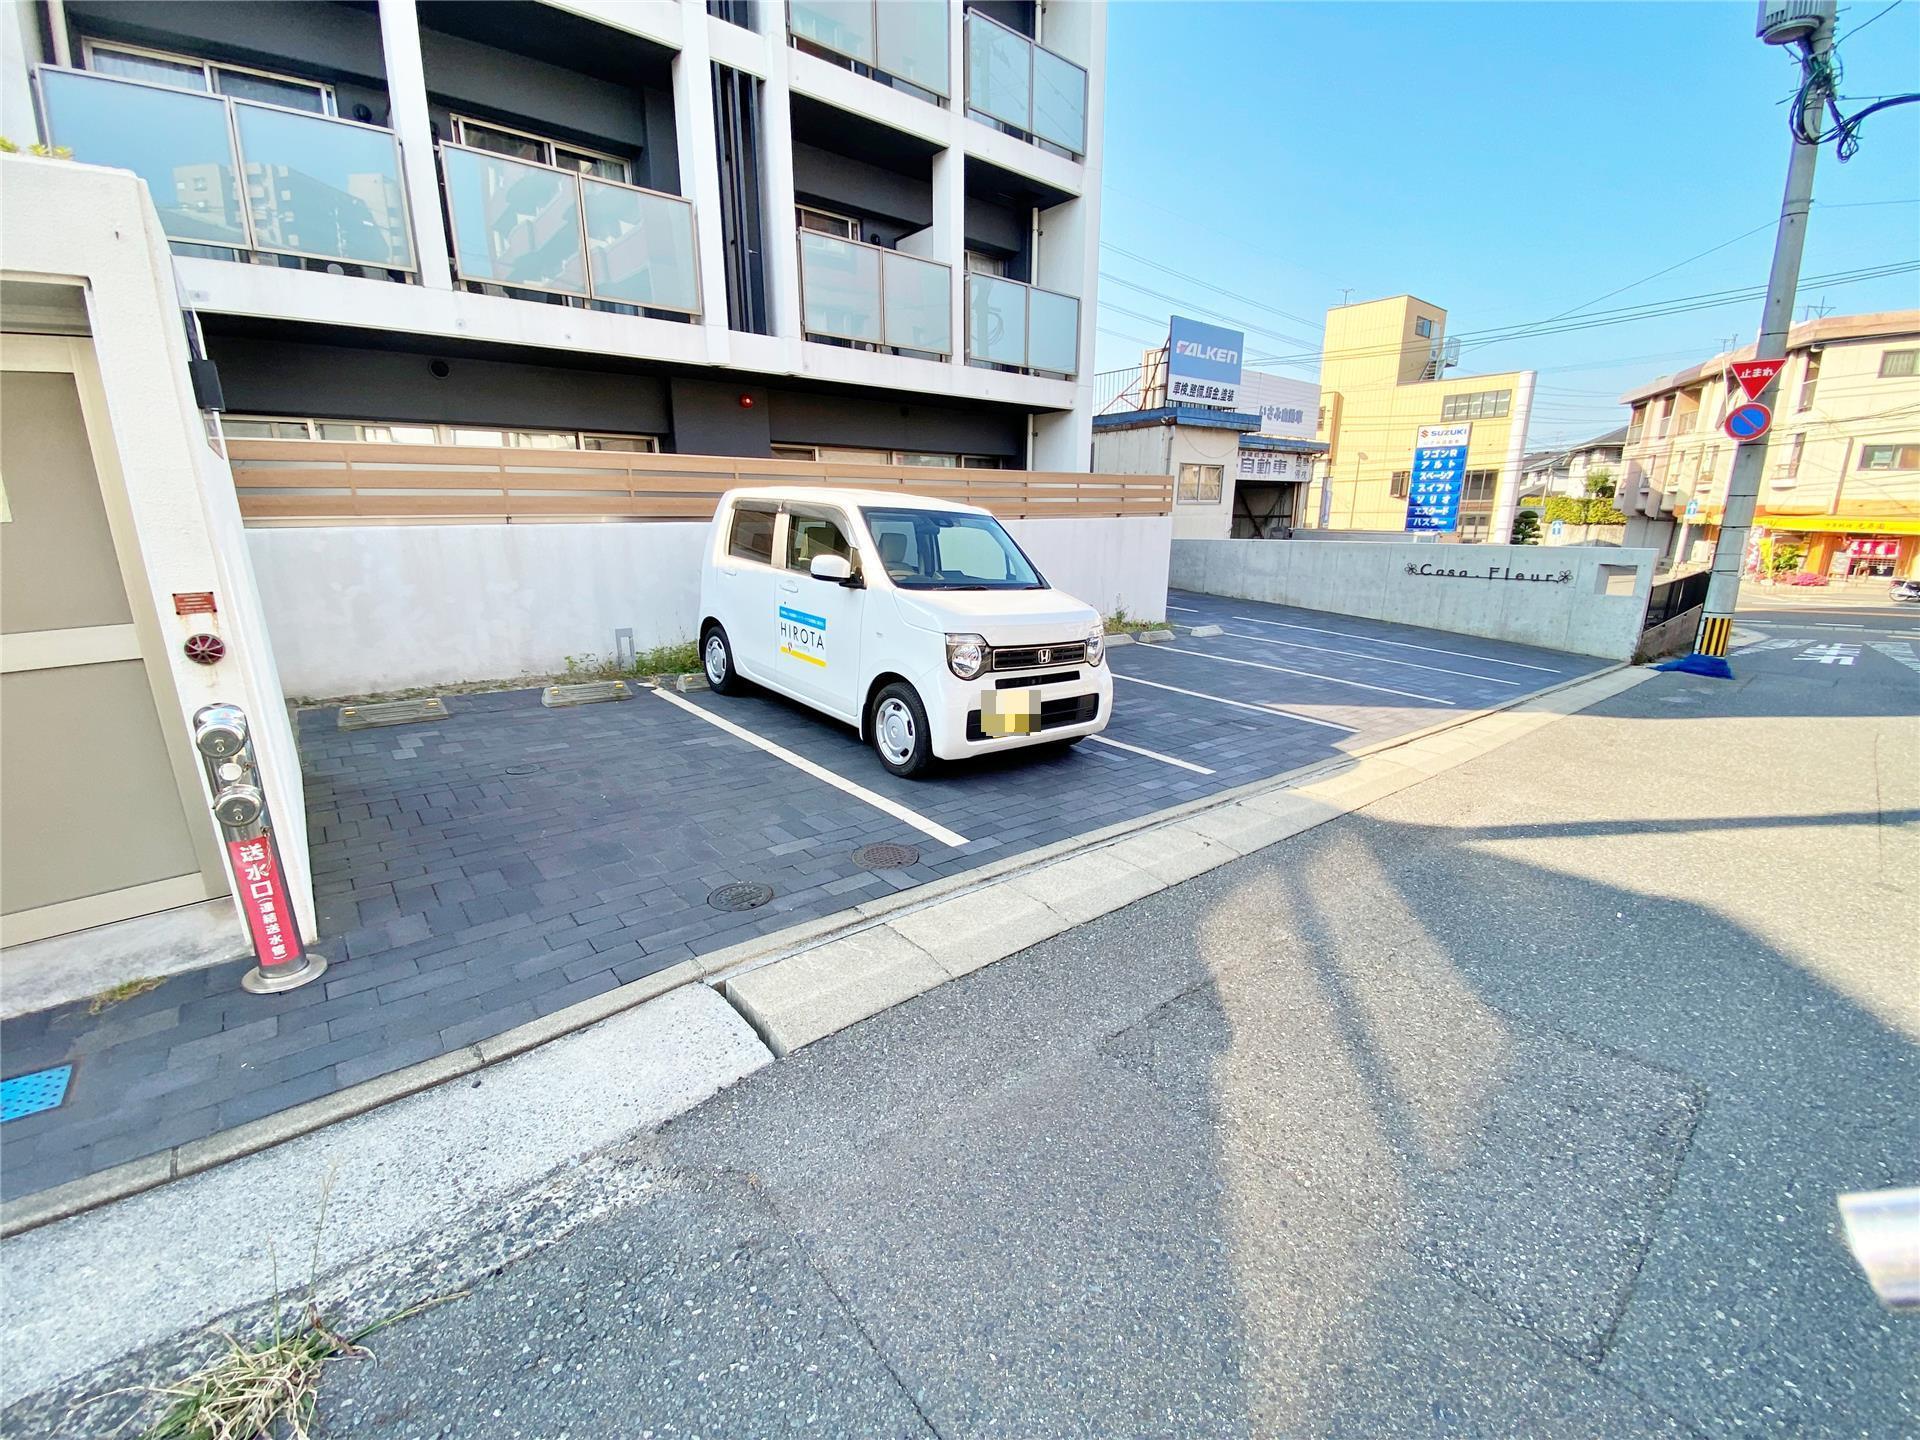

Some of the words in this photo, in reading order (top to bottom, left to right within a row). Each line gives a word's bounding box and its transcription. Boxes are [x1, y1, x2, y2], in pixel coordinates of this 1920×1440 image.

[1176, 340, 1238, 365] FALKEN
[1740, 367, 1774, 379] 止まれ
[1431, 428, 1467, 437] SUZUKI
[1240, 457, 1288, 475] 自動車
[1418, 483, 1452, 493] スイフト
[1413, 517, 1448, 526] ハスラー
[1489, 567, 1554, 582] Fleur
[780, 621, 825, 651] HIROTA
